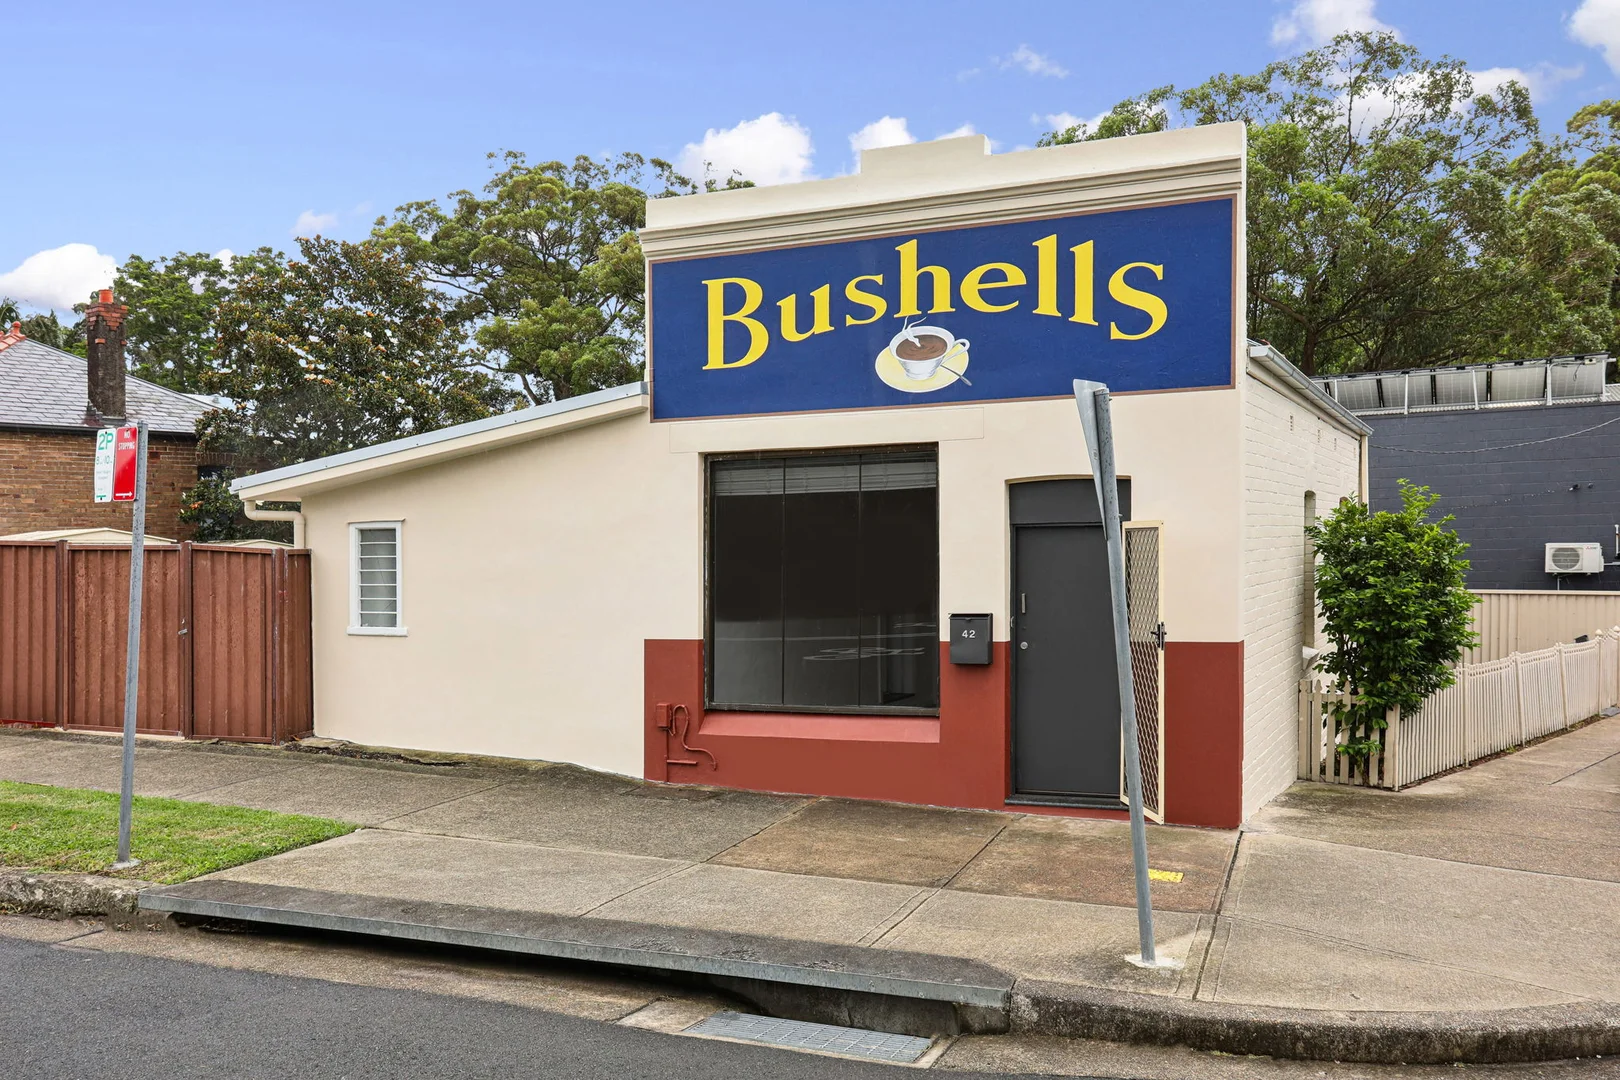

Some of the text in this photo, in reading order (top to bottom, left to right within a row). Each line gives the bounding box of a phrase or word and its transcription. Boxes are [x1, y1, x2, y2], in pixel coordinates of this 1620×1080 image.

[701, 233, 1168, 370] Bushells
[124, 431, 131, 439] NO
[98, 433, 114, 450] 2P
[118, 441, 135, 450] STOPPING
[961, 629, 976, 639] 42
